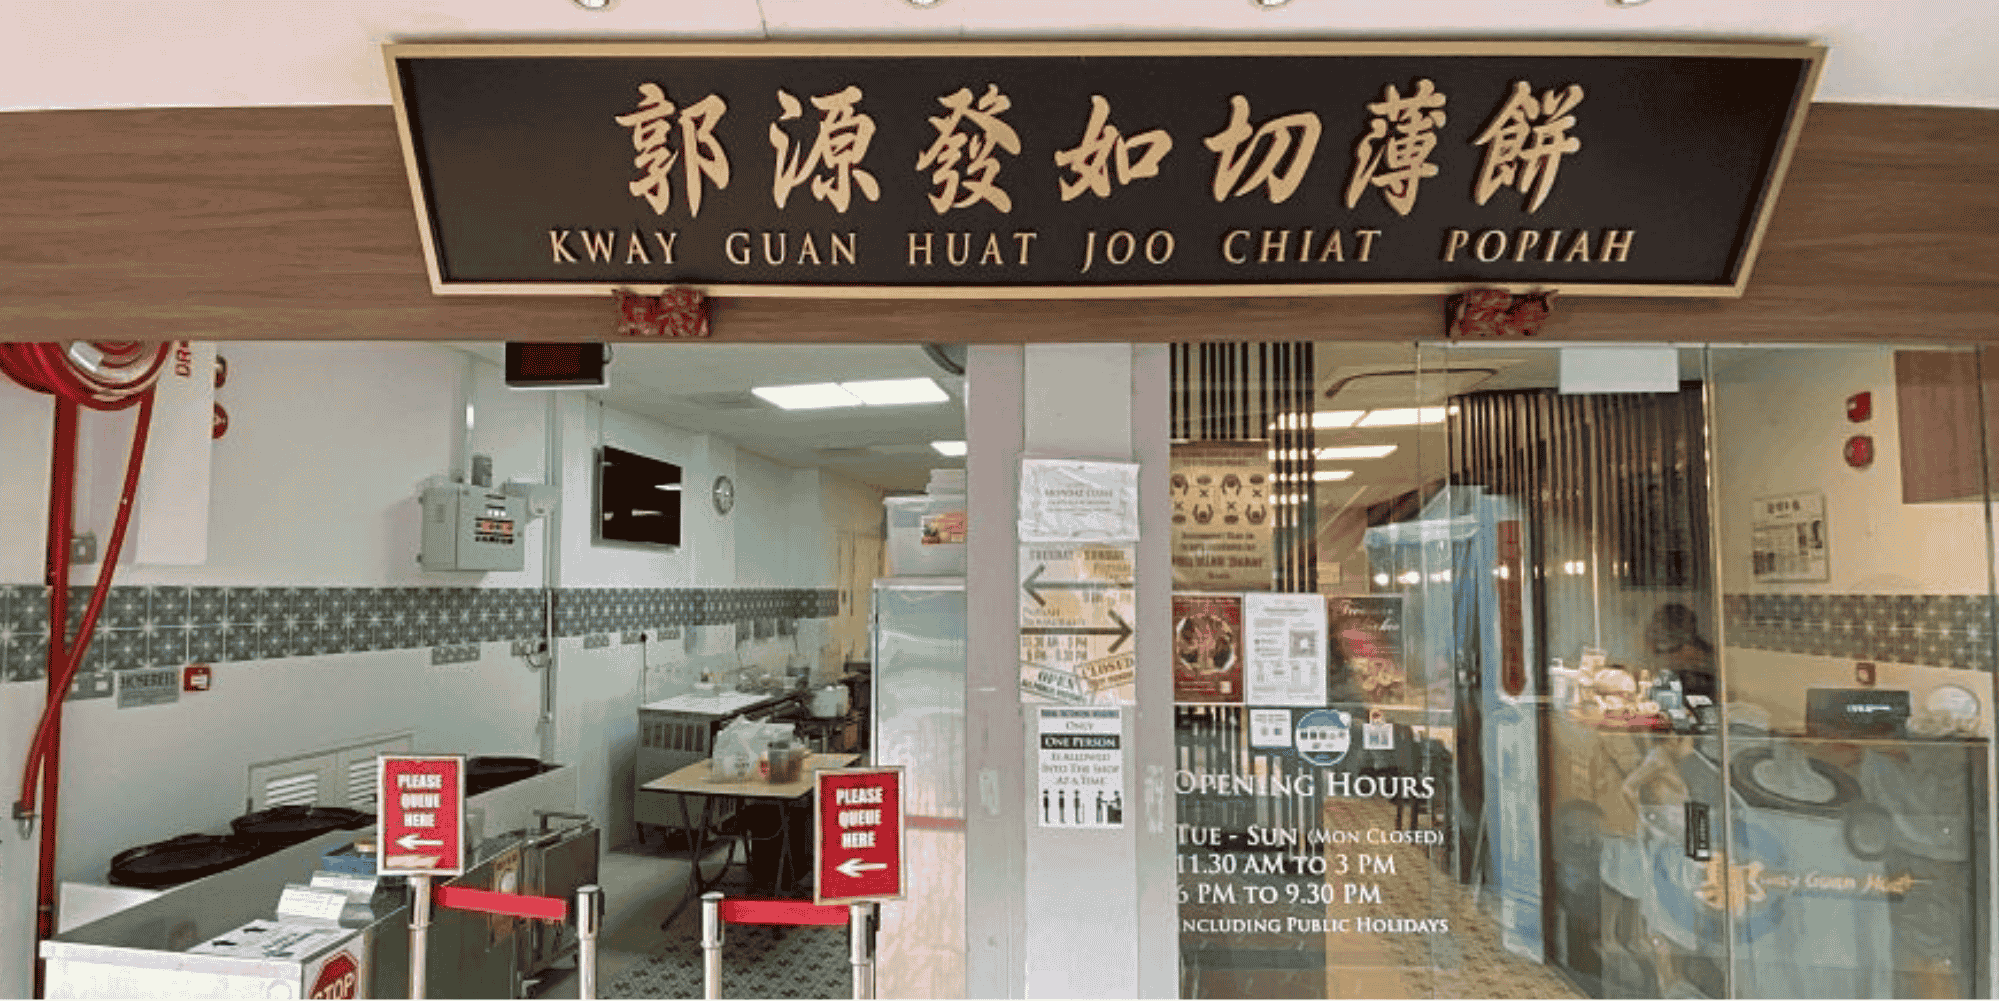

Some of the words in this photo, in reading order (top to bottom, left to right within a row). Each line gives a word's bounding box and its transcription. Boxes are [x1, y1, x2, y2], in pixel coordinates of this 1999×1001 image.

[615, 79, 1583, 217] 郭源發如切薄餅
[550, 231, 677, 265] KWAY
[726, 232, 856, 265] GUAN
[909, 232, 1037, 266] HUAT
[1081, 231, 1175, 273] JOO
[1224, 231, 1382, 264] CHIAT
[1446, 231, 1635, 264] POPIAH
[1045, 737, 1069, 748] ONE
[1073, 737, 1116, 748] PERSON
[396, 774, 443, 789] PLEASE
[1174, 769, 1315, 797] OPENING
[1327, 771, 1436, 799] HOURS
[400, 793, 441, 810] QUEUE
[836, 786, 883, 805] PLEASE
[404, 813, 435, 828] HERE
[838, 809, 882, 829] QUEUE
[841, 831, 876, 848] HERE
[1177, 824, 1222, 846] TUE
[1246, 824, 1298, 847] SUN
[1308, 828, 1360, 844] (MON
[1366, 828, 1445, 845] CLOSED)
[1177, 853, 1237, 875] 11.30
[1242, 853, 1285, 875] AM
[1290, 855, 1327, 875] TO
[1334, 853, 1348, 875] 3
[1358, 853, 1398, 875] PM
[1805, 871, 1856, 889] Guan
[1199, 883, 1236, 905] PM
[1243, 885, 1279, 904] TO
[1285, 882, 1334, 905] 9.30
[1343, 883, 1383, 905] PM
[1181, 918, 1281, 933] NCLUDING
[1286, 917, 1351, 933] PUBLIC
[1356, 917, 1450, 934] HOLIDAYS
[312, 972, 354, 1000] TOP
